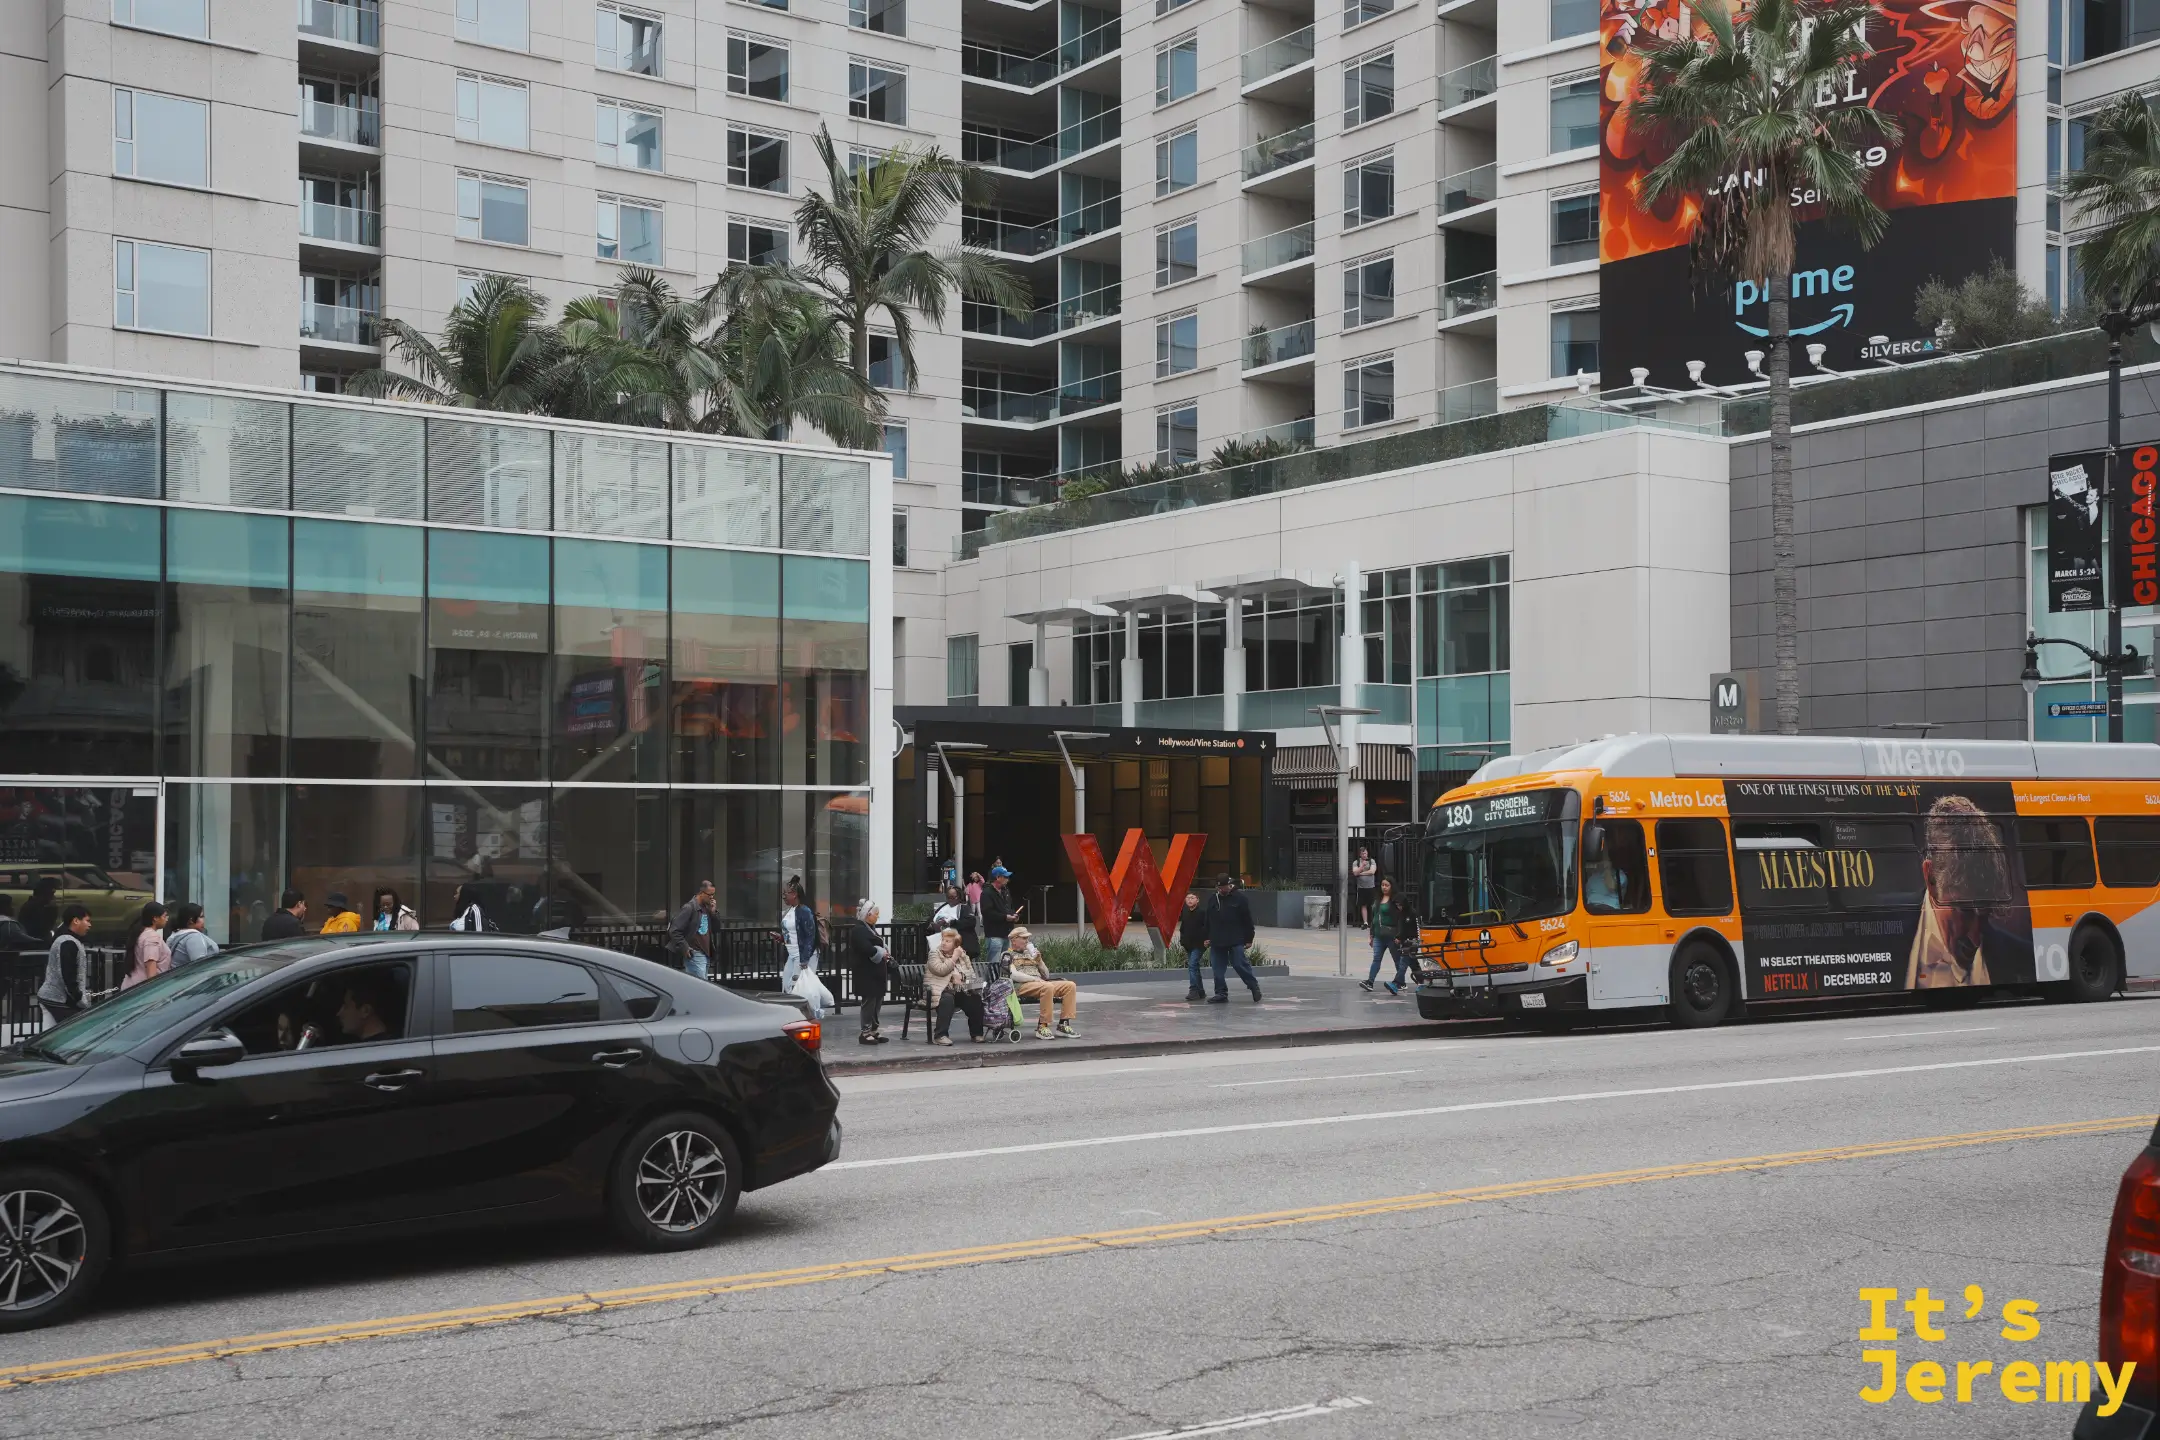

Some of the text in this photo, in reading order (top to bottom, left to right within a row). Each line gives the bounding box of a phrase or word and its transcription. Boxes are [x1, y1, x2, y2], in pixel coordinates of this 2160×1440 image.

[1736, 265, 1855, 316] prme
[2131, 446, 2159, 605] CHICAGO
[2054, 569, 2077, 578] MARCH
[1718, 684, 1738, 708] M
[1158, 737, 1236, 748] Hollywood/Vine Station
[1876, 741, 1965, 776] Metro
[1608, 791, 1631, 804] 5624
[1763, 783, 1775, 796] OF
[1778, 784, 1797, 796] THE
[1798, 784, 1830, 796] FINEST
[1831, 784, 1860, 796] FILMS
[1861, 784, 1873, 796] OF
[1875, 785, 1894, 796] THE
[1490, 796, 1529, 812] PASADENA
[1650, 791, 1728, 808] Metro Loca
[2030, 794, 2050, 805] Largest
[1446, 804, 1473, 828] 180
[1484, 806, 1536, 822] CITY COLLEGE
[1758, 850, 1875, 890] MAESTRO
[1061, 828, 1208, 950] W
[1540, 917, 1565, 932] 5624
[1760, 952, 1892, 967] IN SELECT THEATERS NOVEMBER
[1763, 972, 1809, 993] NETFLIX
[1823, 971, 1892, 987] DECEMBER 20
